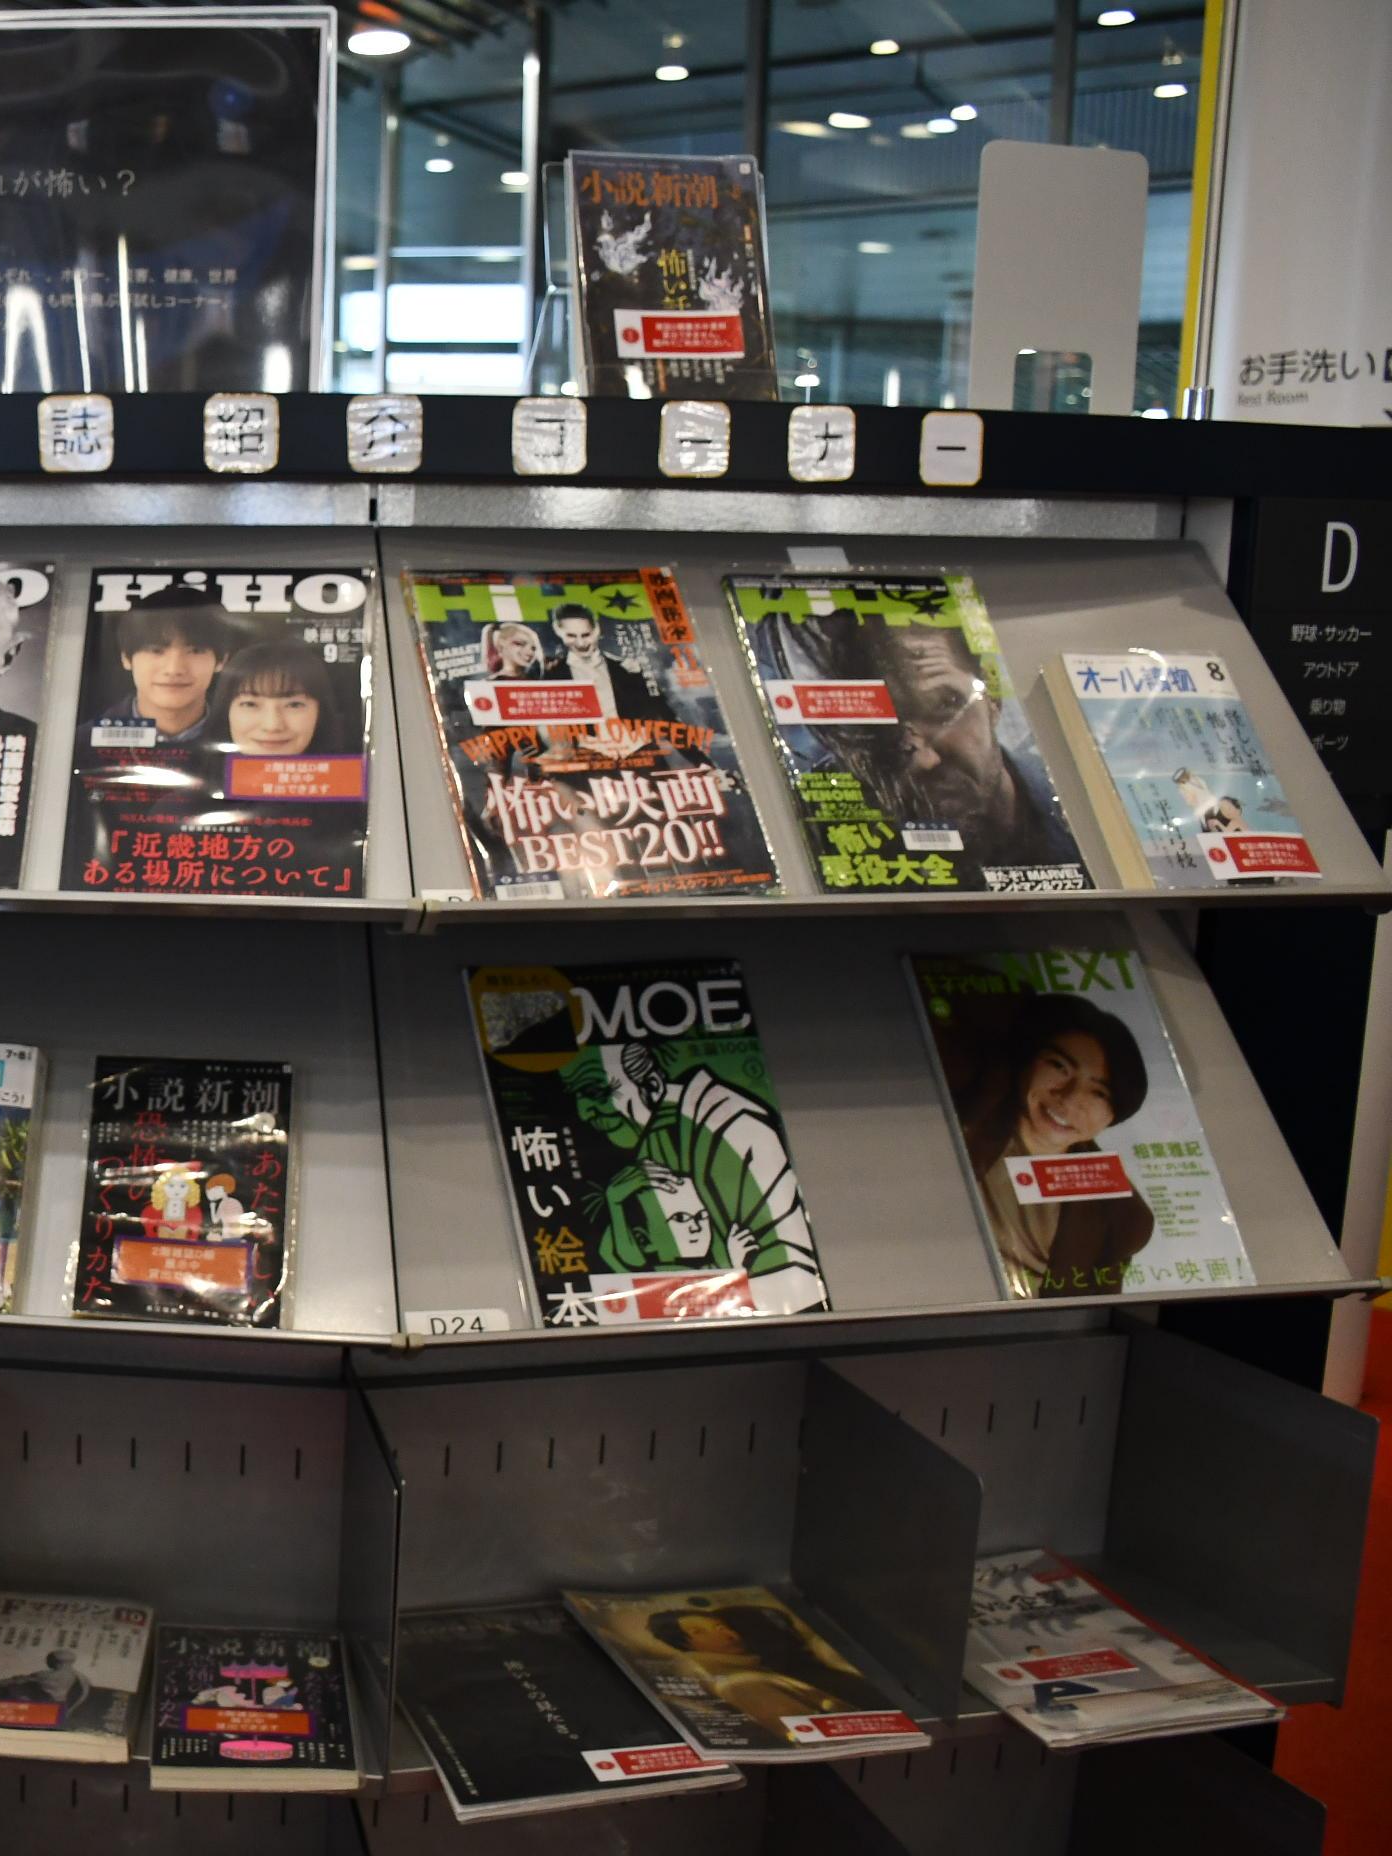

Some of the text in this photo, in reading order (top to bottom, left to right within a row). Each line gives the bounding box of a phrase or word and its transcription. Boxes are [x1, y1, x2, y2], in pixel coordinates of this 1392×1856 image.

[580, 169, 720, 209] 小説新潮
[1239, 348, 1376, 386] お手洗い
[1321, 520, 1359, 594] D
[1290, 624, 1373, 643] 野球・サッカー
[323, 643, 338, 663] 9
[1303, 660, 1360, 679] アウトドア
[1205, 661, 1226, 682] 8
[458, 725, 540, 763] HAPPY
[1311, 733, 1350, 751] ポーツ
[483, 762, 730, 847] 怖い映画
[108, 830, 295, 860] 『近畿地方の
[517, 816, 727, 875] BEST20!!
[826, 822, 895, 855] 怖い
[82, 859, 353, 892] ある場所について』
[1027, 864, 1084, 881] MARVEL
[1002, 950, 1138, 994] NEXT
[569, 978, 754, 1042] MOE
[102, 1074, 281, 1116] 小説新潮
[511, 1124, 602, 1327] 怖い絵本
[429, 1315, 486, 1335] D24
